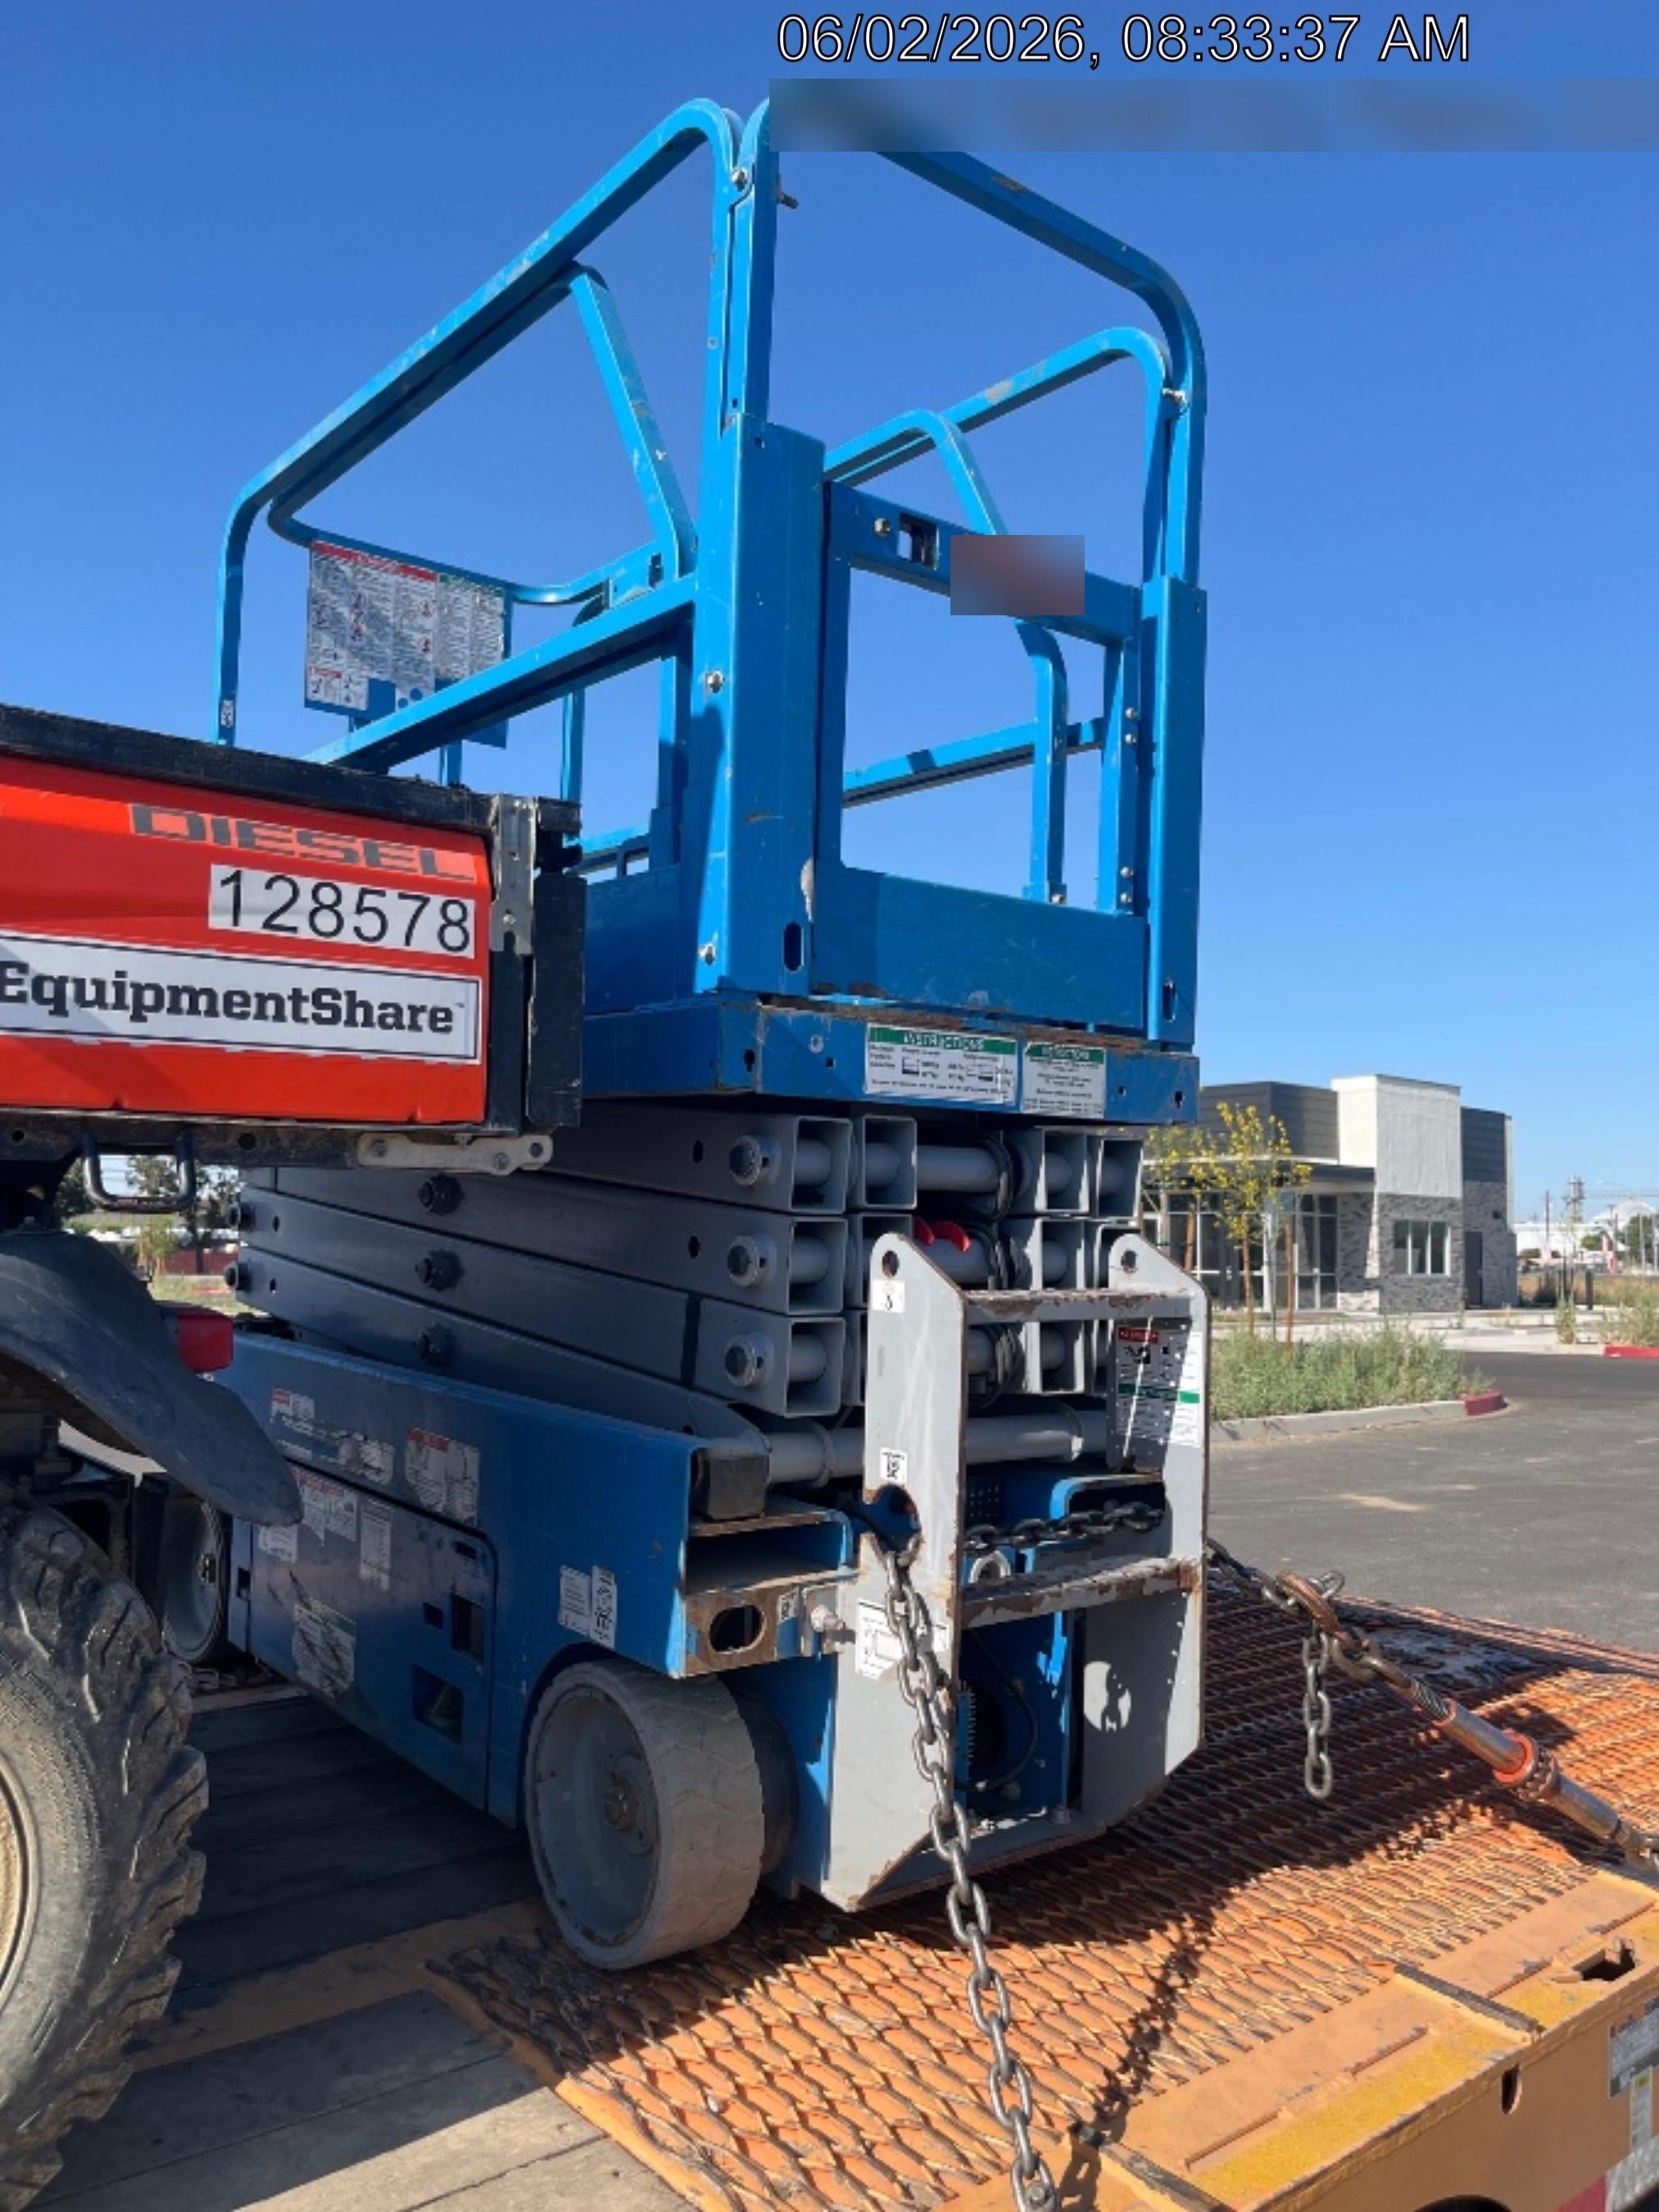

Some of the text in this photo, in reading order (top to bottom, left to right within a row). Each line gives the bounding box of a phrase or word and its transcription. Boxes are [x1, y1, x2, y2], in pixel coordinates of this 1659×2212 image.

[133, 804, 475, 881] DIESEL
[220, 869, 470, 952] 128578
[0, 960, 454, 1033] EquipmentShare
